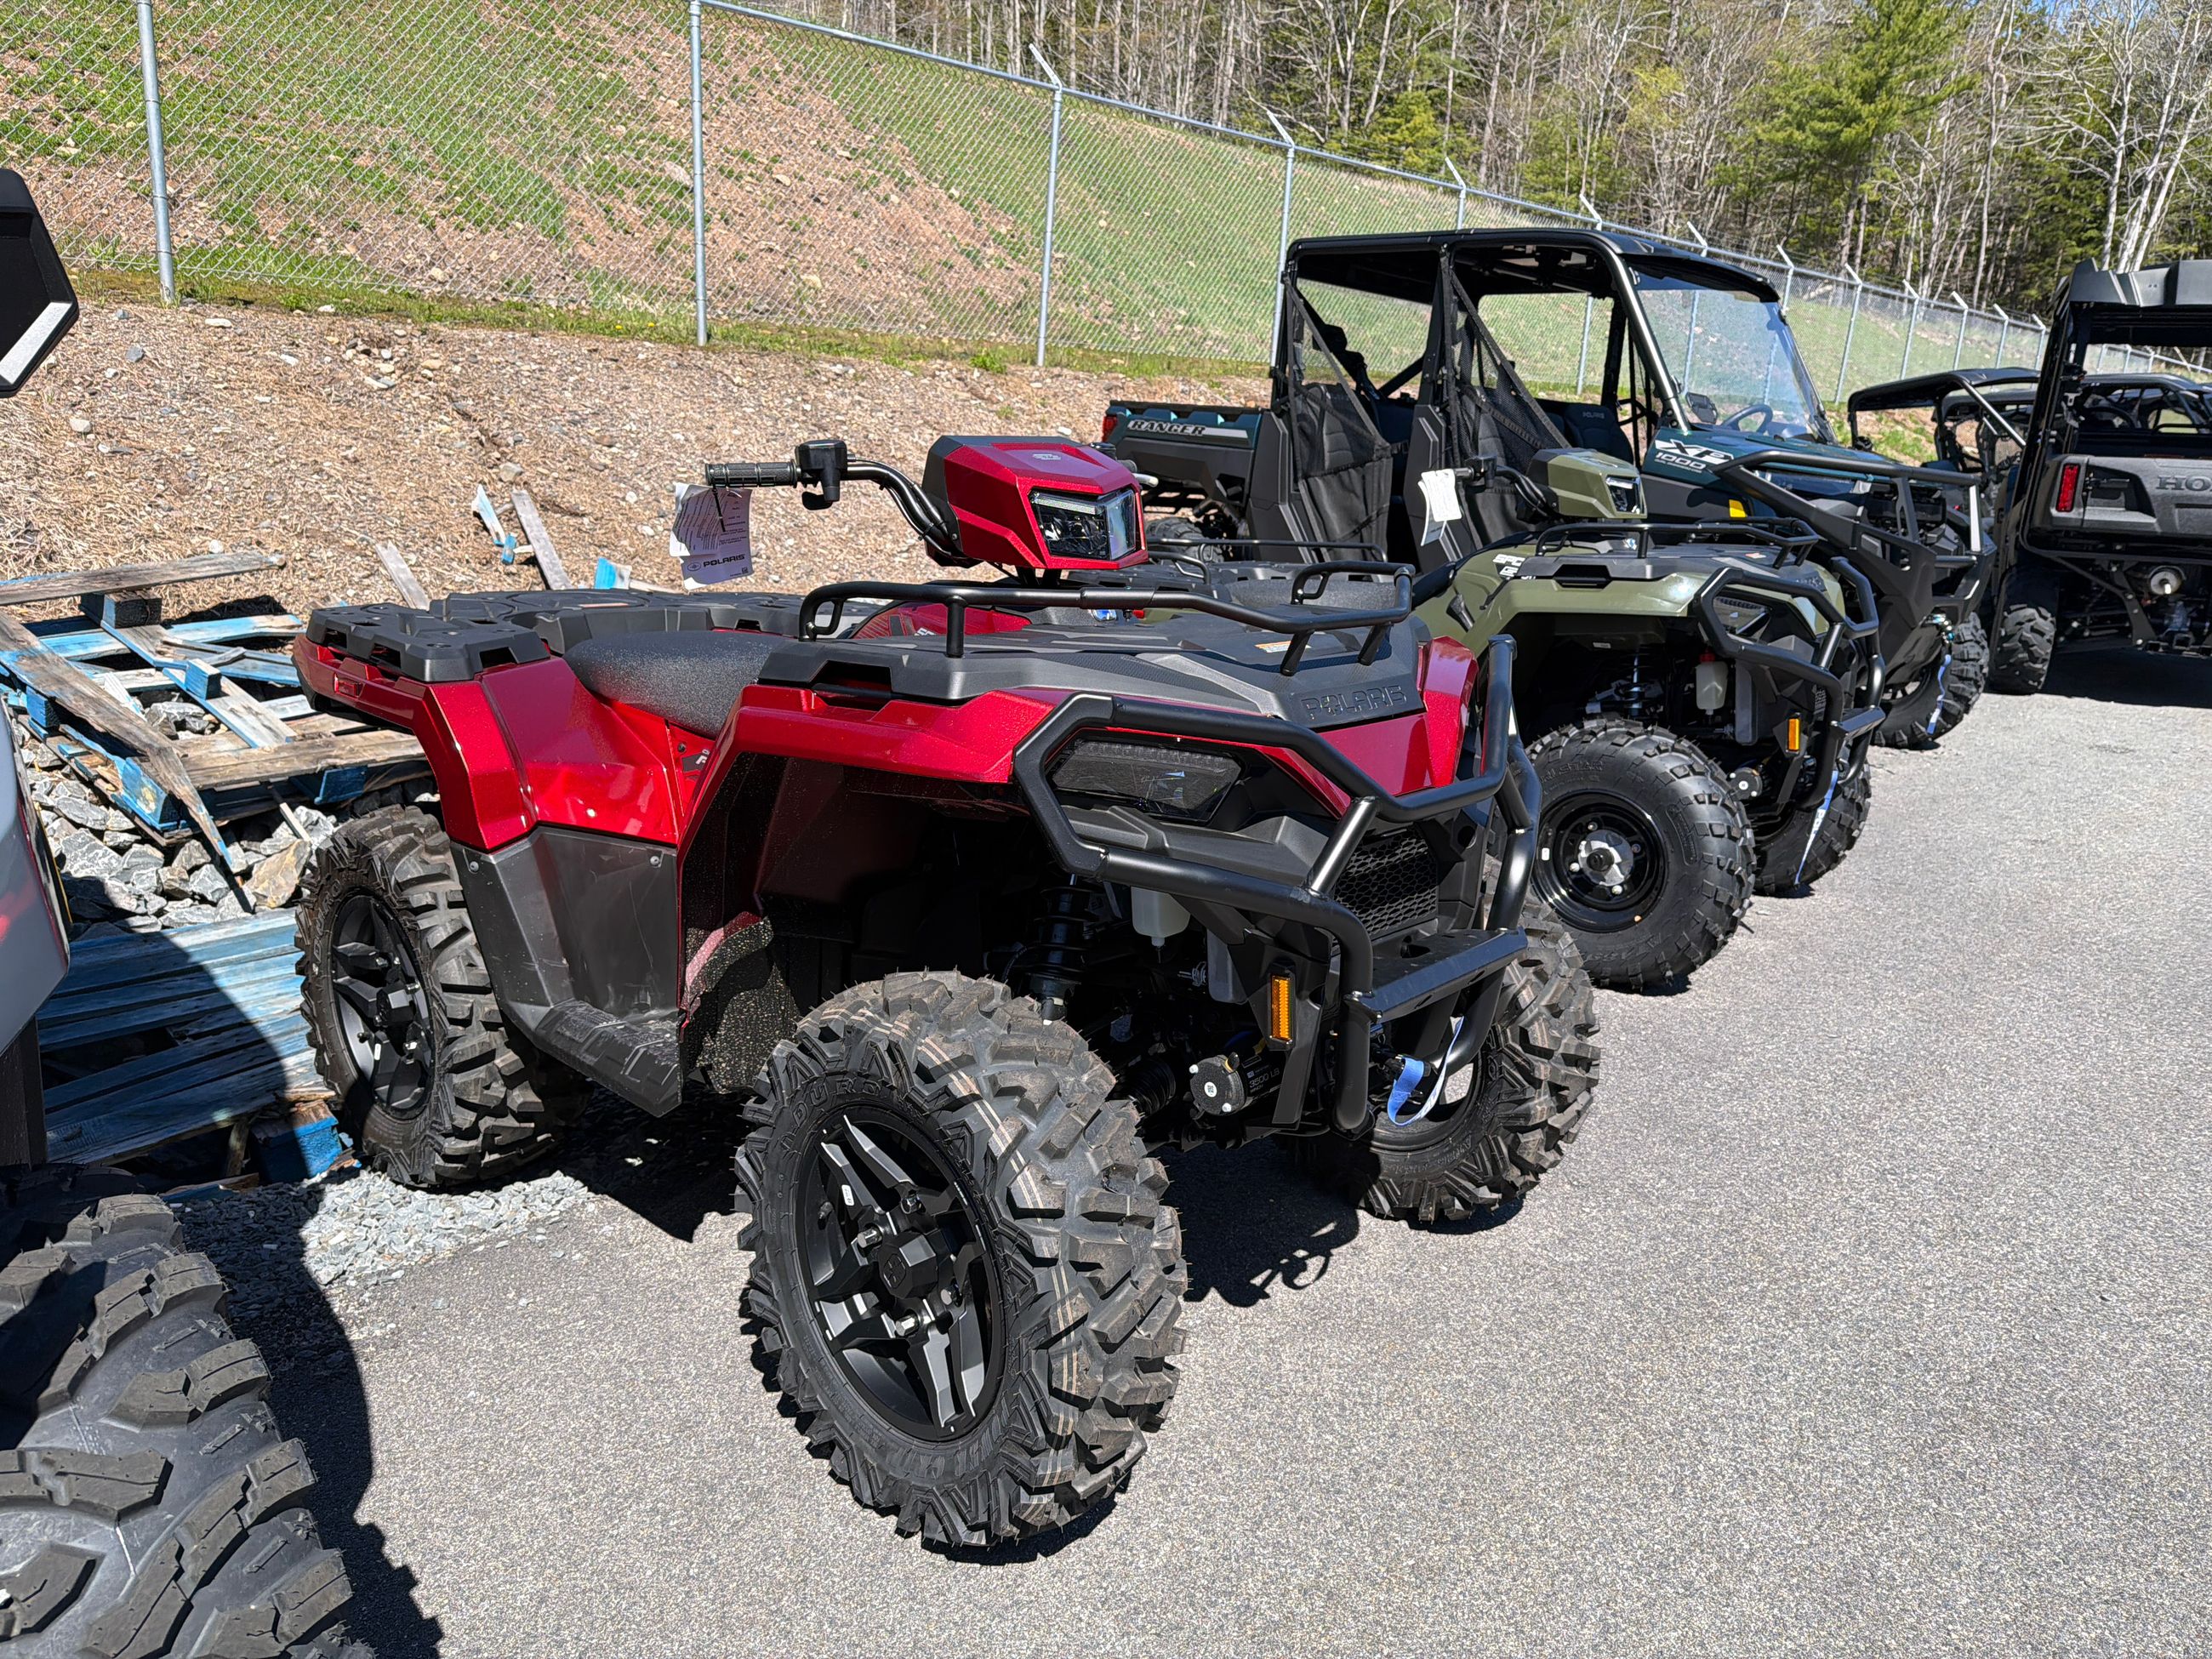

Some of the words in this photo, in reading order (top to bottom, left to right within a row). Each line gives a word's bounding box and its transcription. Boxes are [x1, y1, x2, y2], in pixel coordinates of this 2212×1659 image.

[1130, 419, 1206, 436] RANGER
[1655, 452, 1707, 470] 1000
[2155, 475, 2212, 492] HO
[703, 554, 746, 567] POLARIS
[1301, 685, 1406, 720] POLARIS
[1249, 1073, 1269, 1088] 3500
[1270, 1068, 1280, 1079] LB
